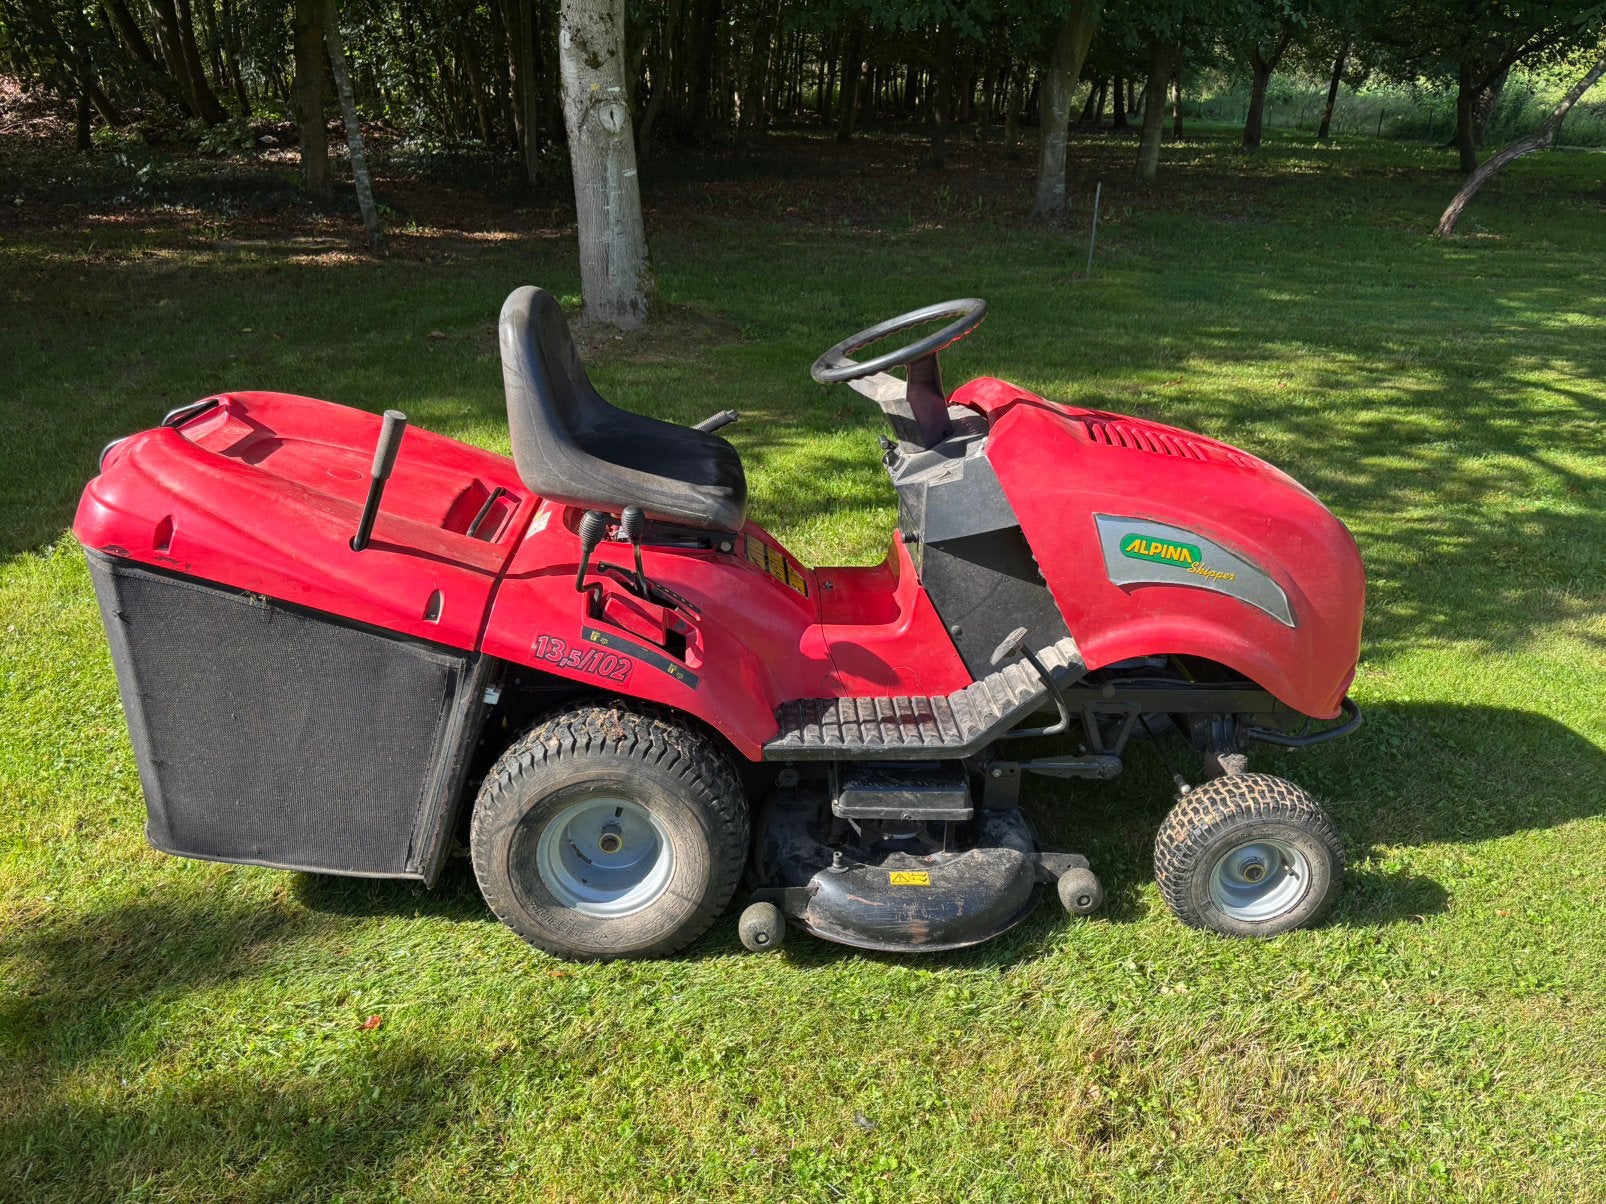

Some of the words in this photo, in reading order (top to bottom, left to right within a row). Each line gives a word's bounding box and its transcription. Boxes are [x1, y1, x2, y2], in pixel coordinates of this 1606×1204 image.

[1125, 539, 1193, 564] ALPINA
[1186, 561, 1236, 581] Skipper
[534, 635, 633, 682] 13,5/102
